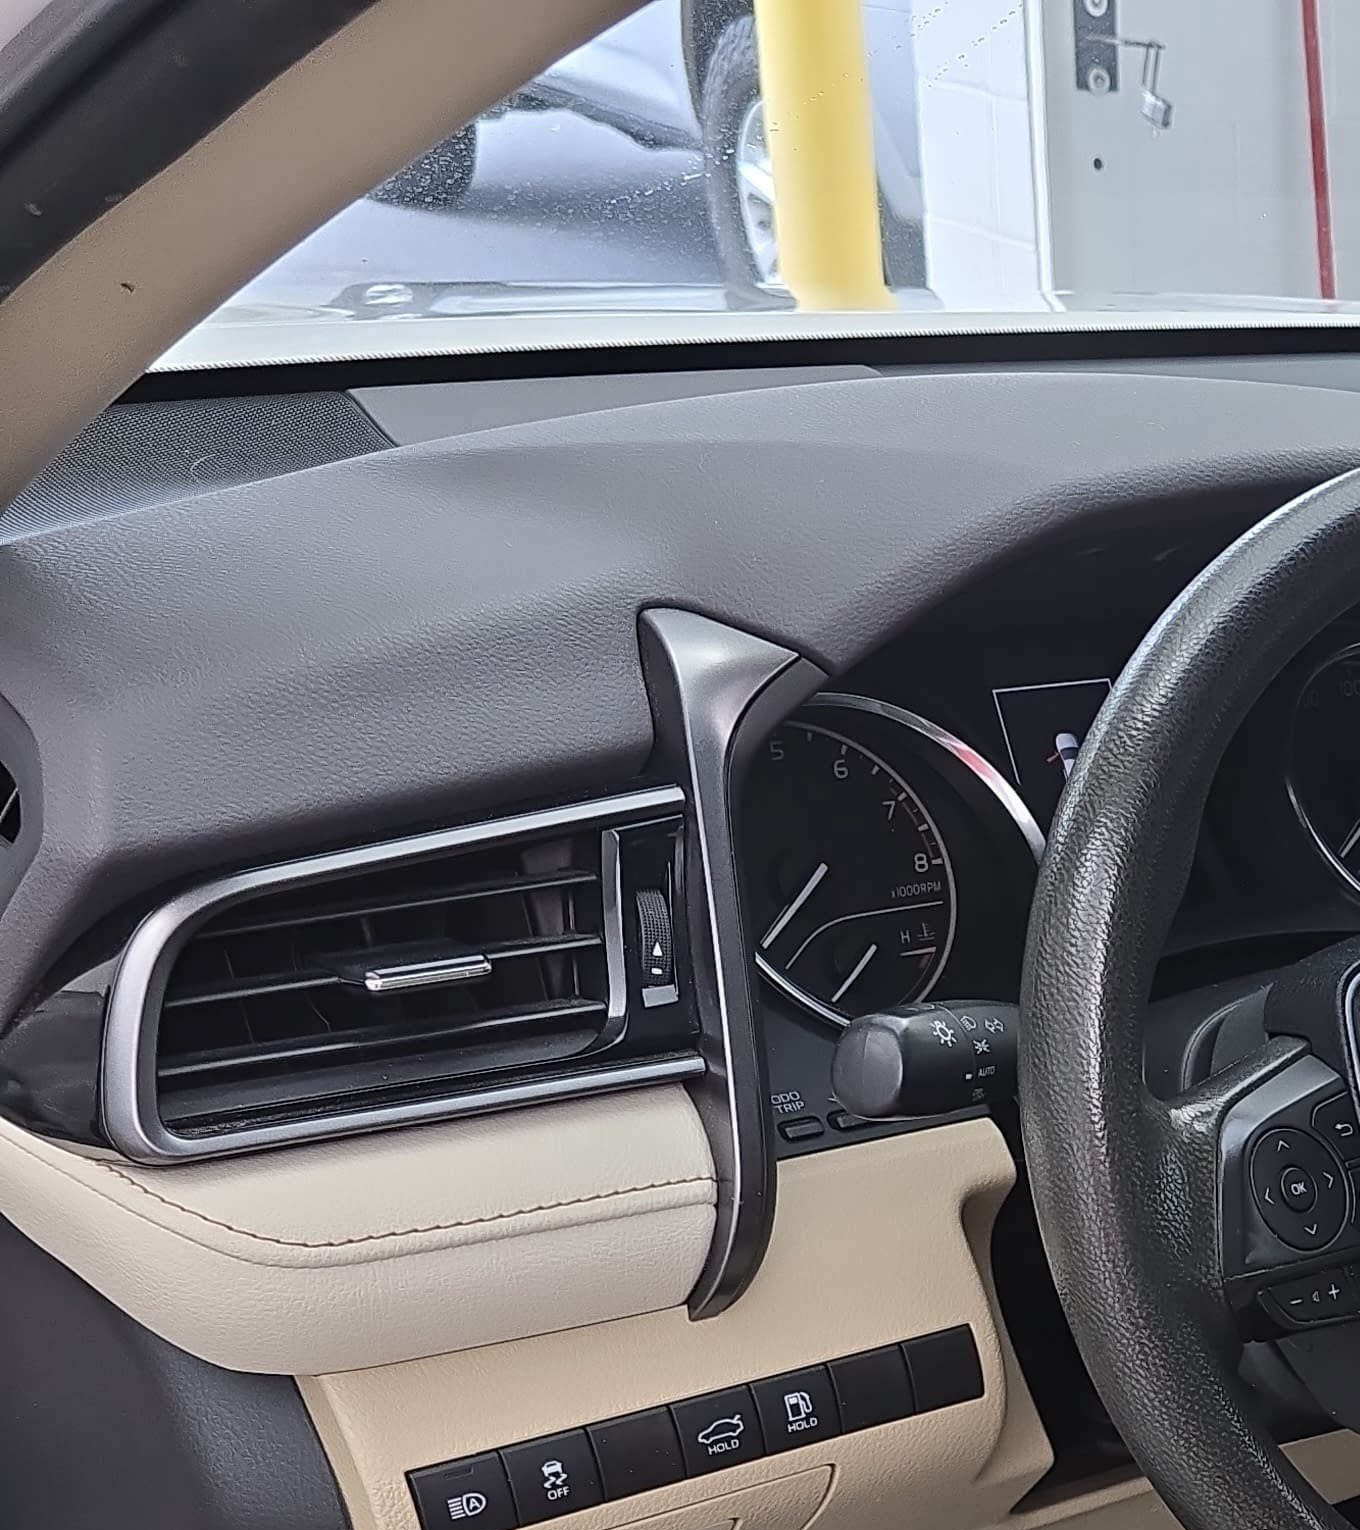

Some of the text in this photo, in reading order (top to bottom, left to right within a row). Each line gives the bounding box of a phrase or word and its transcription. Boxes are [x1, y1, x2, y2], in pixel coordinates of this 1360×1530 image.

[769, 740, 785, 761] 5
[833, 759, 849, 779] 6
[881, 801, 896, 821] 7
[913, 853, 929, 873] 8
[900, 929, 911, 944] H
[977, 1065, 996, 1079] AUTO
[771, 1090, 801, 1106] ODO
[776, 1100, 805, 1114] TRIP
[1290, 1182, 1308, 1196] OK
[787, 1417, 818, 1433] HOLD
[708, 1439, 740, 1456] HOLD
[547, 1486, 570, 1501] OFF
